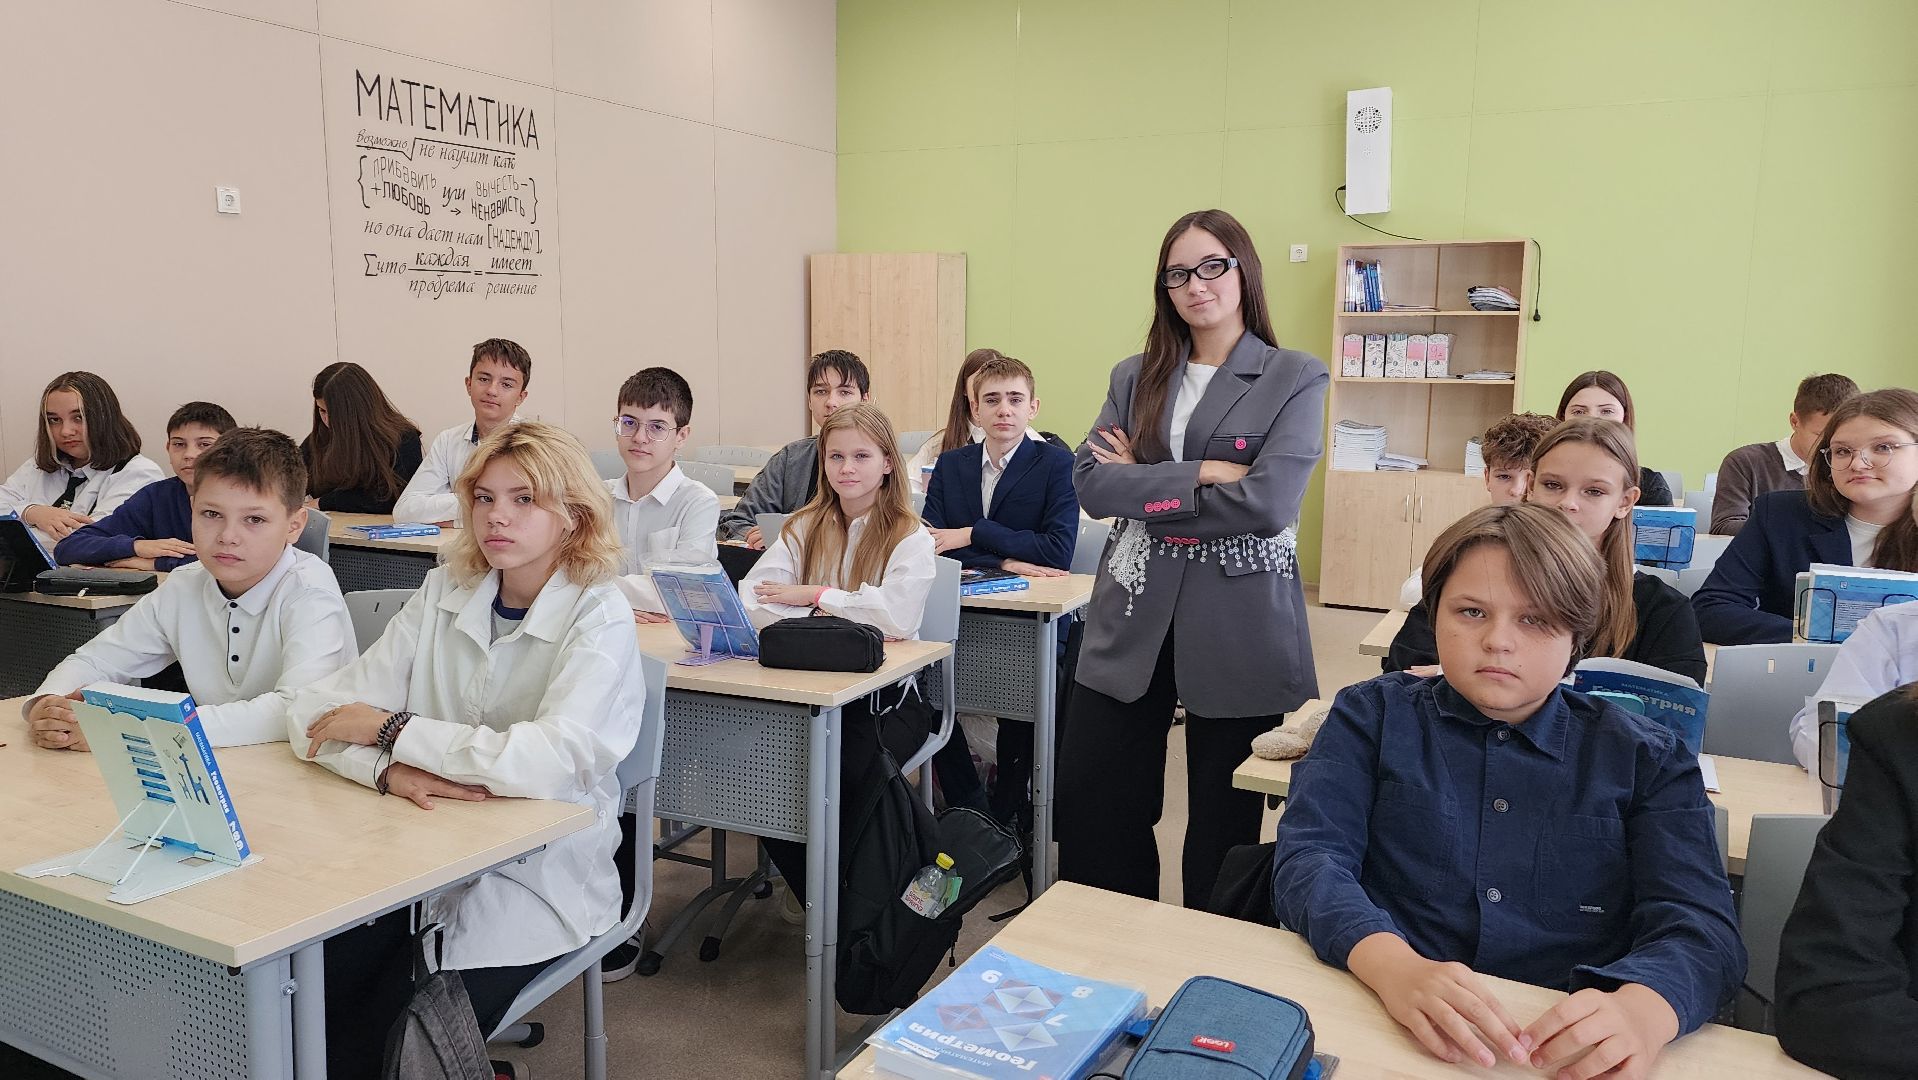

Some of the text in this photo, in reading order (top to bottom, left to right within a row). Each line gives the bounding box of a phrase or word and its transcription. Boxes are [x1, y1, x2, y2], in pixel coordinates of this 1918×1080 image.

[356, 69, 539, 150] МАТЕМАТИКА
[419, 143, 434, 158] не
[439, 147, 490, 169] научит
[493, 155, 516, 170] как
[442, 186, 466, 208] или
[364, 220, 383, 235] но
[385, 223, 414, 238] она
[456, 231, 484, 246] нам
[415, 247, 470, 267] каждая
[491, 256, 532, 271] имеет
[408, 274, 537, 300] проблема решение
[1071, 984, 1093, 1000] 8
[1044, 1013, 1069, 1027] 7
[908, 1022, 1038, 1071] Геометрия
